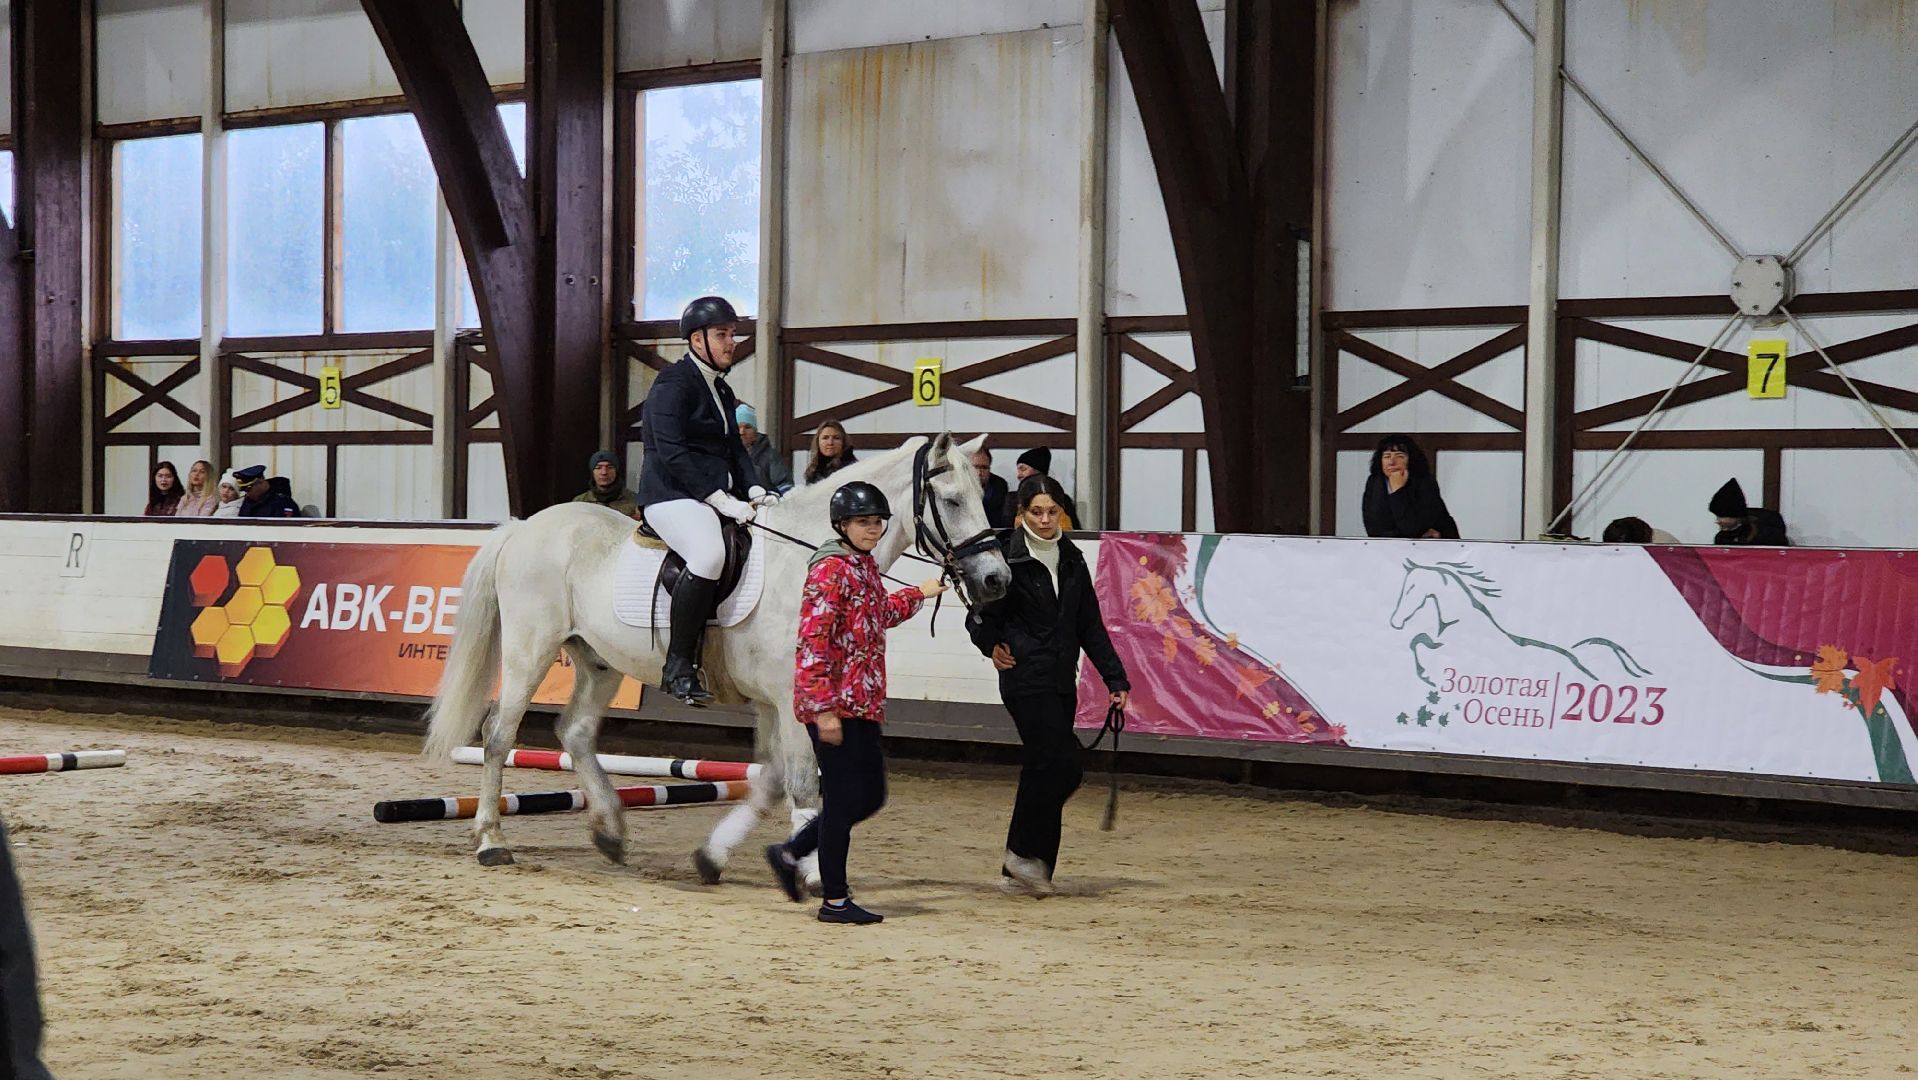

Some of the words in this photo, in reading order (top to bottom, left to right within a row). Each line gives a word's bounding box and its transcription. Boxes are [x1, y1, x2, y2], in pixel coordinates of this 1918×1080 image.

[919, 368, 936, 402] 6
[1756, 353, 1780, 393] 7
[326, 376, 337, 405] 5
[66, 532, 84, 568] R
[300, 583, 464, 635] АВК-ВЕ
[398, 642, 449, 661] ИНТЕ
[1440, 667, 1550, 698] Золотая
[1463, 698, 1545, 728] Осень
[1560, 682, 1668, 726] 2023
